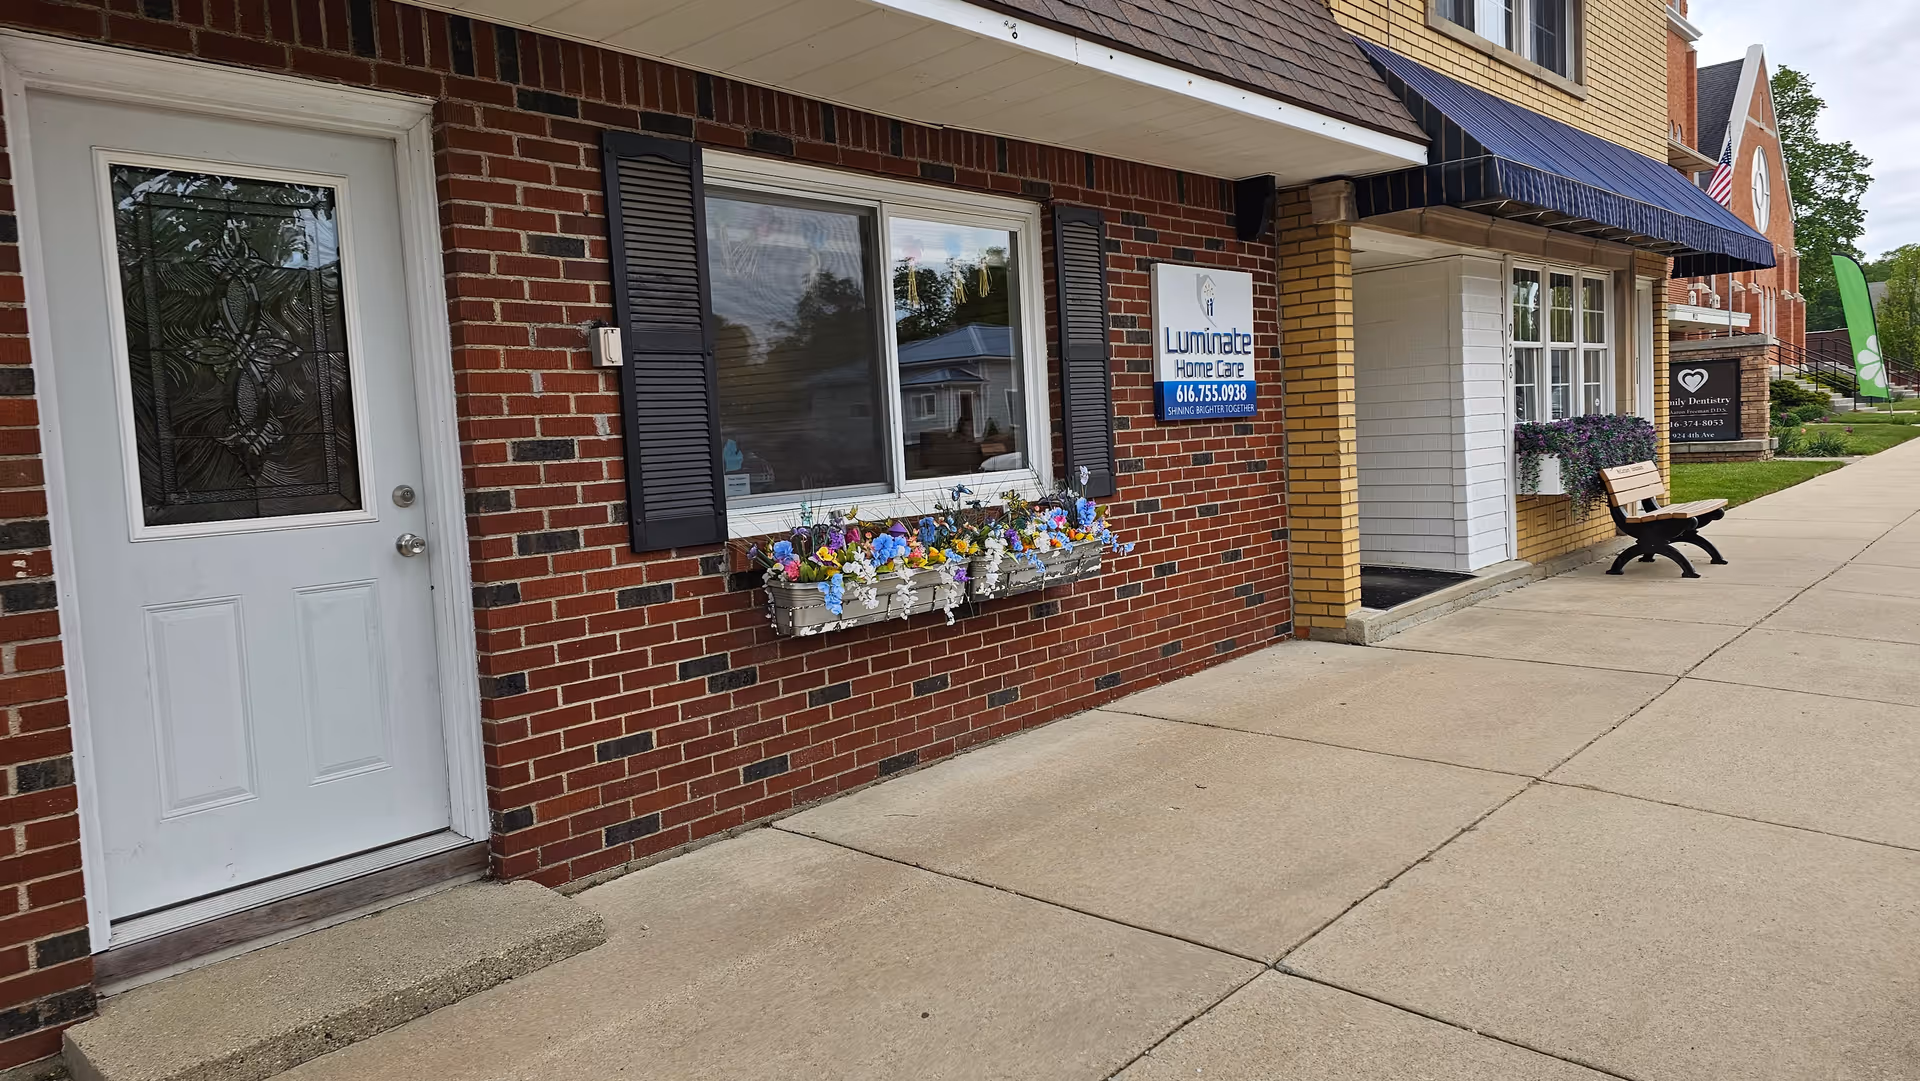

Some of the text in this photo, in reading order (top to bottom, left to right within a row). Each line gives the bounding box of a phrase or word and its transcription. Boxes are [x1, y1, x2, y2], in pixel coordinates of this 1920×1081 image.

[1165, 326, 1252, 355] Luminate
[1175, 359, 1245, 378] Home Care
[1176, 384, 1246, 402] 616.755.0938
[1689, 396, 1731, 406] Dentistry
[1167, 403, 1255, 416] SHINING BRIGHTER TOGETHER
[1670, 419, 1724, 428] 16-374-8053
